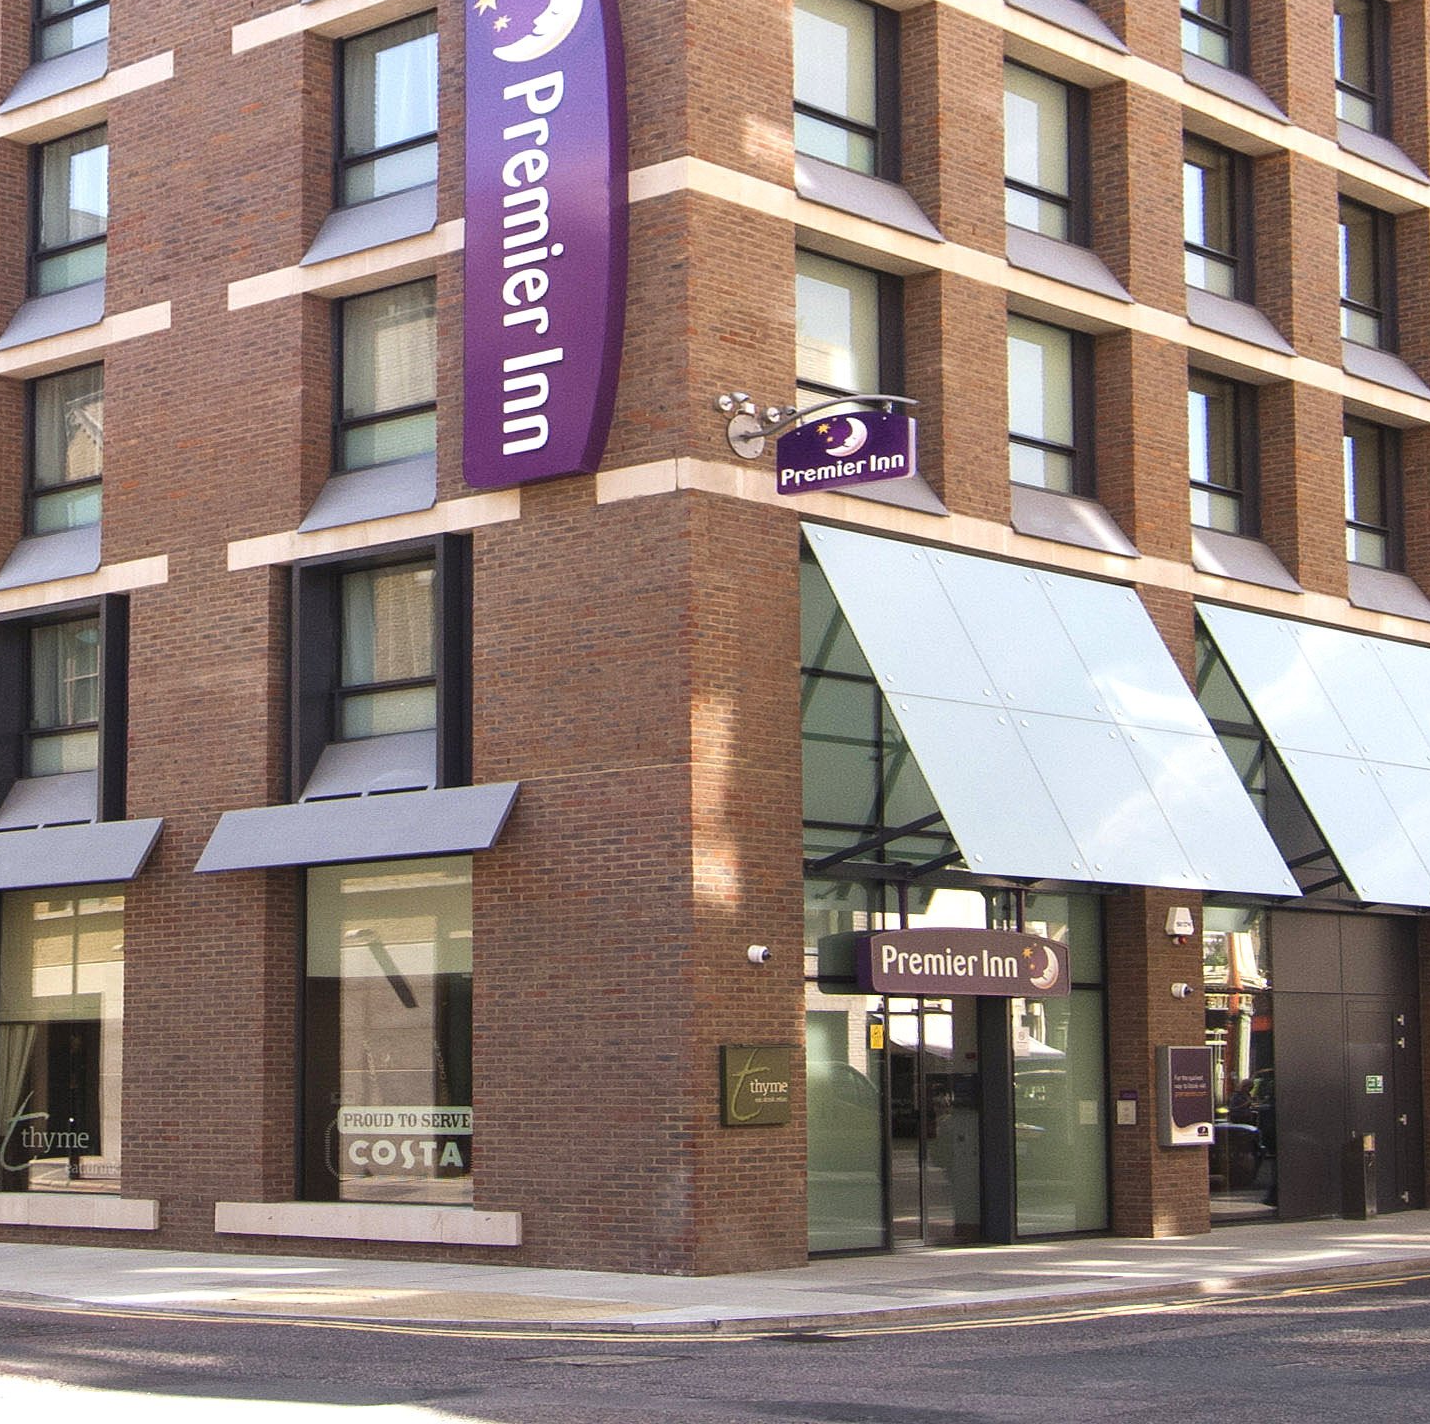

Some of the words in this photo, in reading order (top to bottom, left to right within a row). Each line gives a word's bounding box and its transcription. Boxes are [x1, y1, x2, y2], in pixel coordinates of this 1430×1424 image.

[502, 70, 564, 335] Premier
[502, 347, 564, 456] Inn
[781, 460, 868, 486] Premier
[870, 454, 905, 472] Inn
[881, 944, 978, 976] Premier
[982, 949, 1018, 978] Inn
[750, 1079, 788, 1096] thyme
[342, 1113, 394, 1127] PROUD
[397, 1113, 417, 1127] TO
[421, 1113, 471, 1128] SERVE
[21, 1126, 90, 1153] thyme
[348, 1139, 465, 1169] COSTA
